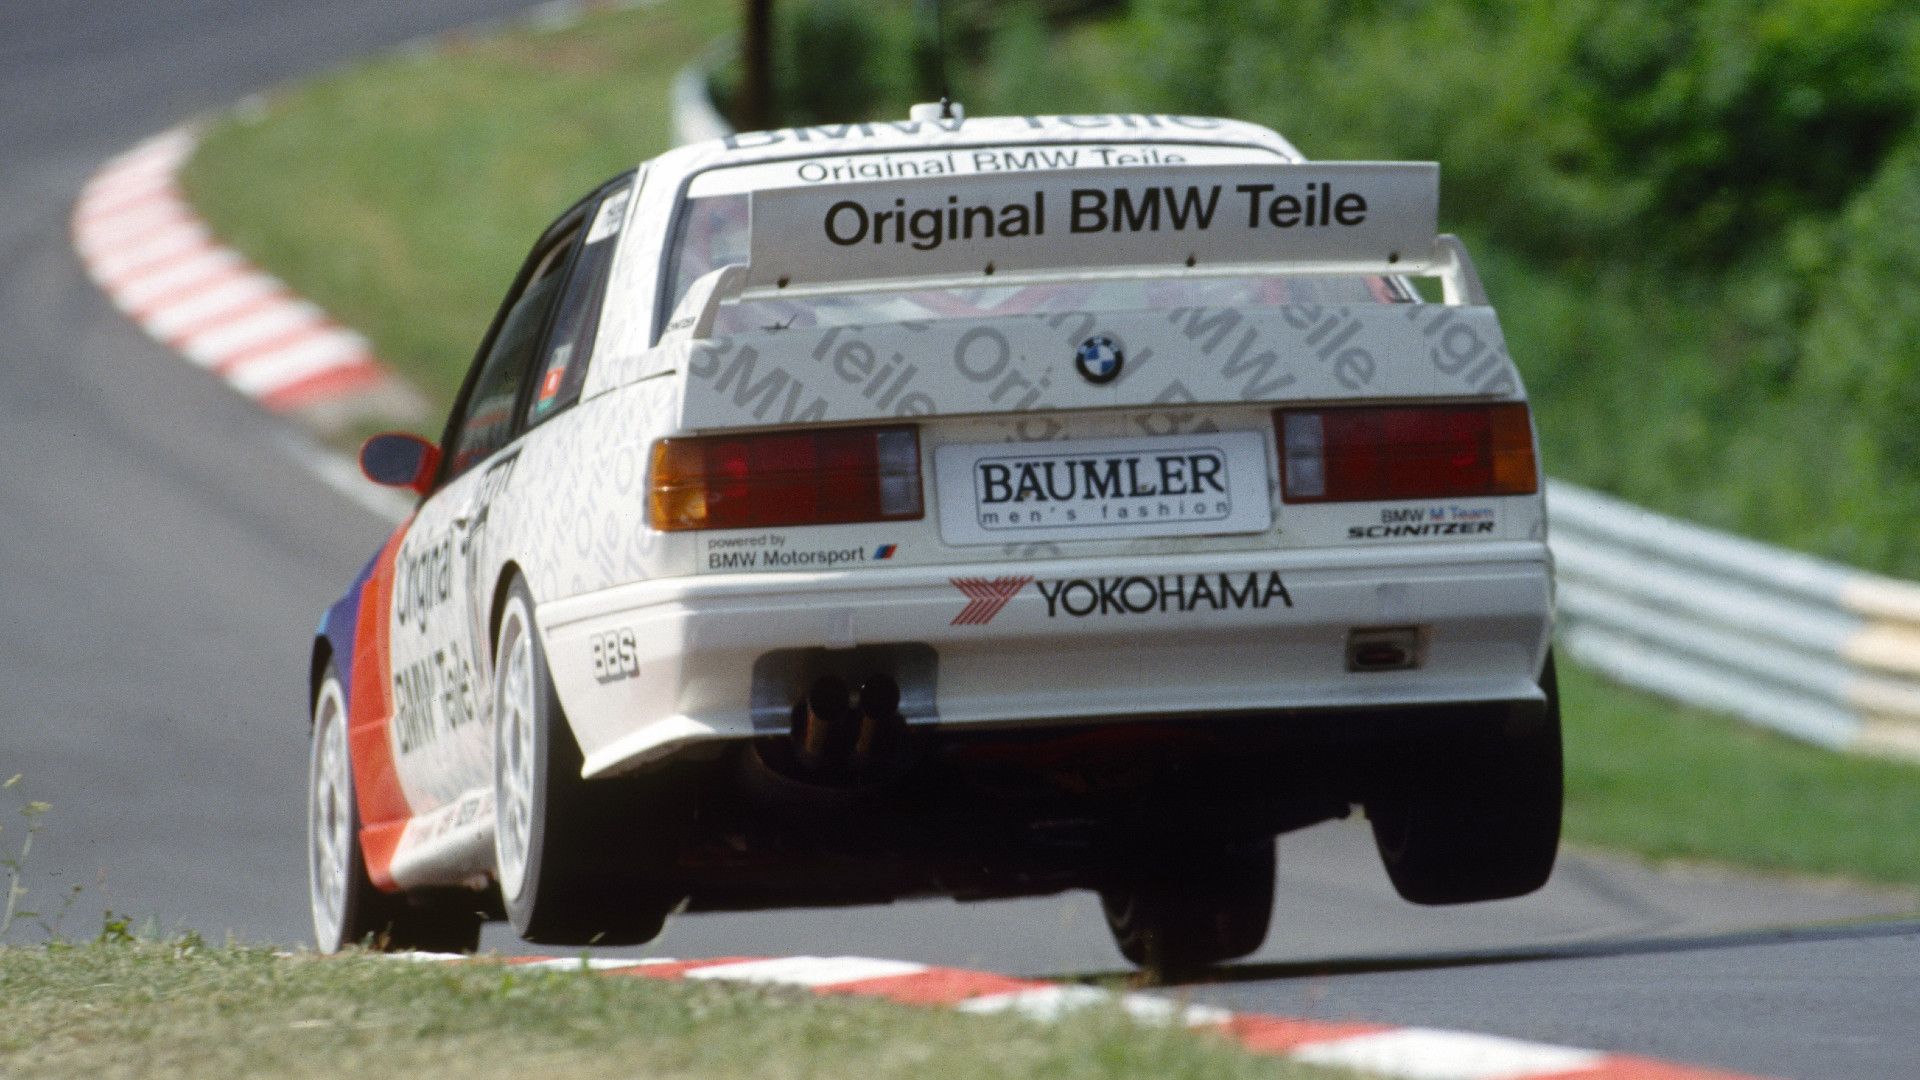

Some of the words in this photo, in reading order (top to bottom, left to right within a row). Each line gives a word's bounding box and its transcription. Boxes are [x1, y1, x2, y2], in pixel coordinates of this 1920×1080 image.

[797, 154, 956, 182] Original
[971, 150, 1078, 172] BMW
[1090, 148, 1186, 166] Teile
[824, 190, 1045, 250] Original
[1069, 186, 1222, 234] BMW
[1236, 183, 1368, 229] Teile
[980, 454, 1225, 503] BÄUMLER
[982, 506, 1077, 524] men's
[1101, 501, 1228, 520] fashion
[1381, 508, 1424, 523] BMW
[708, 534, 767, 549] powered
[770, 533, 786, 547] by
[1347, 521, 1495, 538] SCHNITZER
[708, 551, 757, 570] BMW
[763, 546, 865, 566] Motorsport
[1035, 571, 1293, 618] YOKOHAMA
[590, 626, 641, 685] BBS
